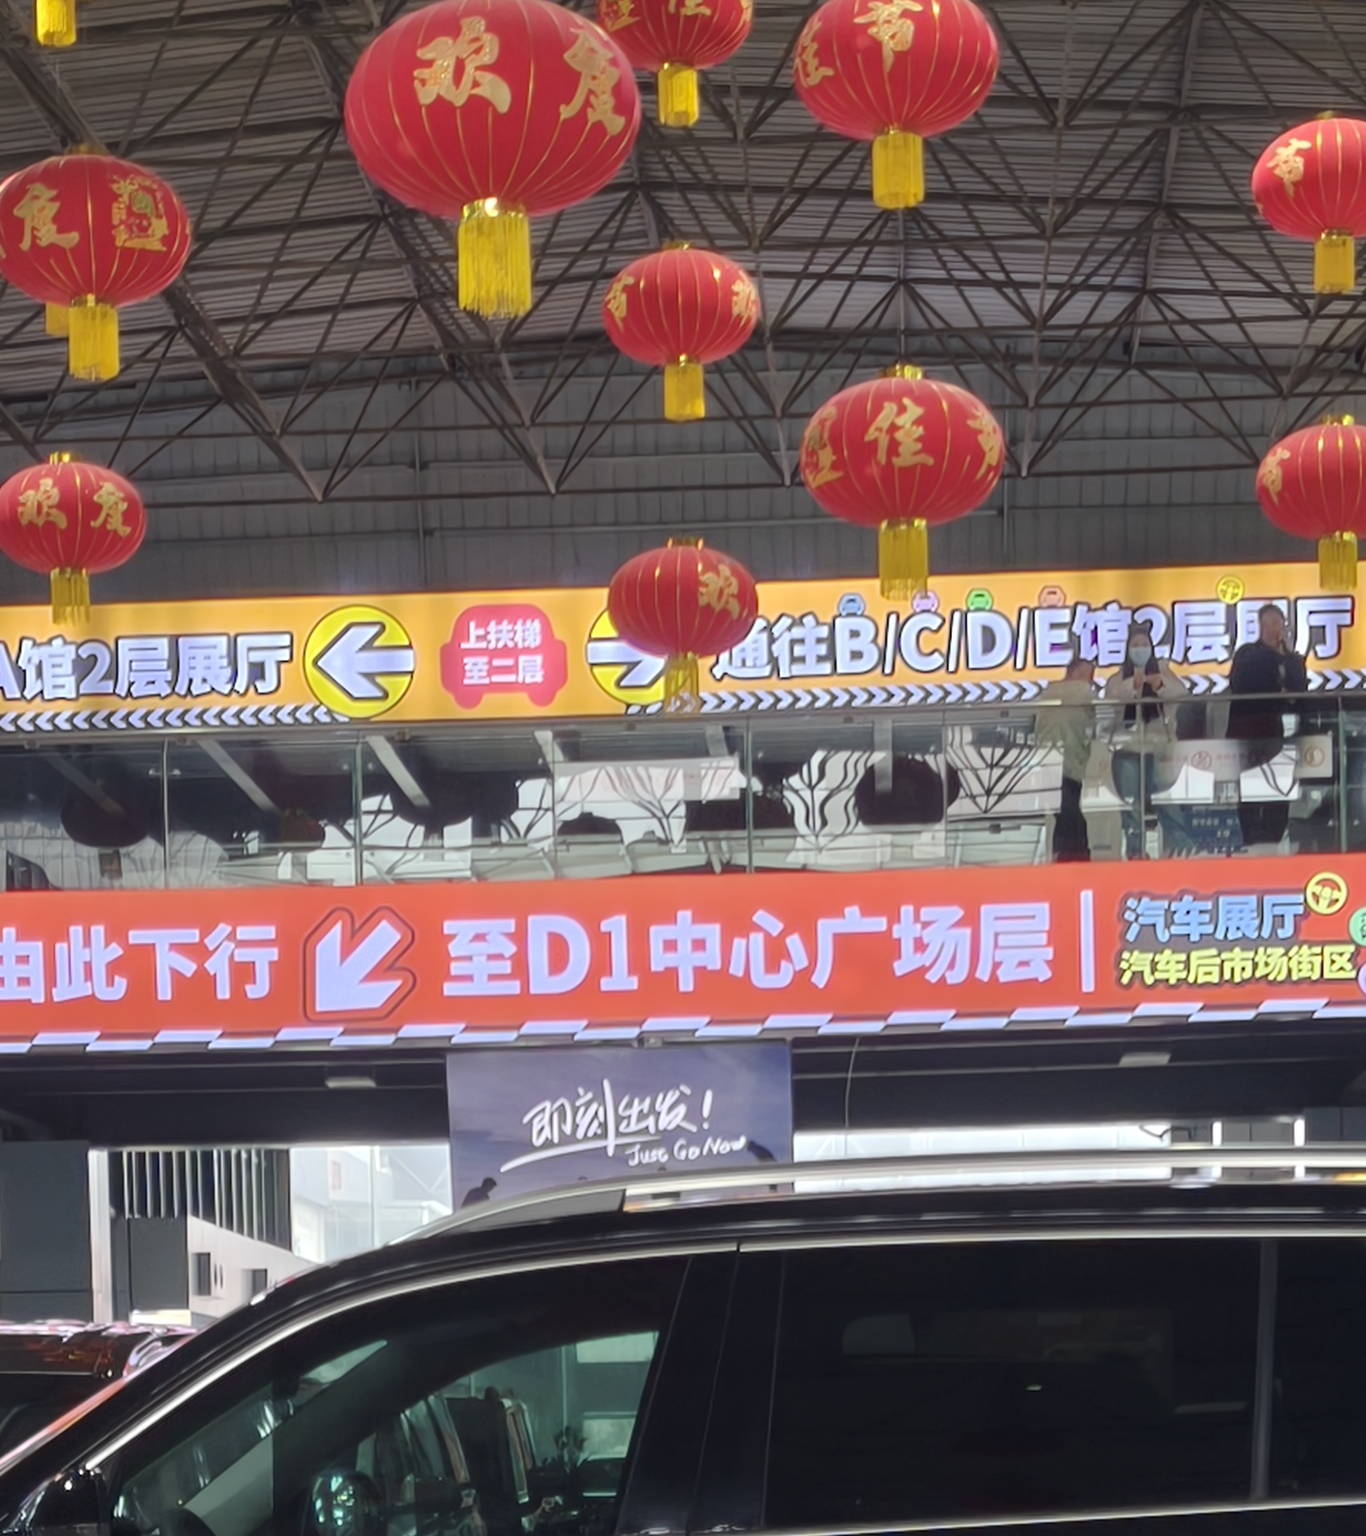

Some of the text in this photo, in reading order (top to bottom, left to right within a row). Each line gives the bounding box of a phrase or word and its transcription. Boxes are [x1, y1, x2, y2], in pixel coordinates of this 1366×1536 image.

[459, 618, 542, 650] 上扶梯
[462, 653, 545, 685] 至二层
[1123, 893, 1307, 943] 汽车展厅
[442, 901, 1056, 998] 至D1中心广场层
[1118, 943, 1358, 986] 汽车后市场街区
[624, 1134, 748, 1168] Just Go Now
